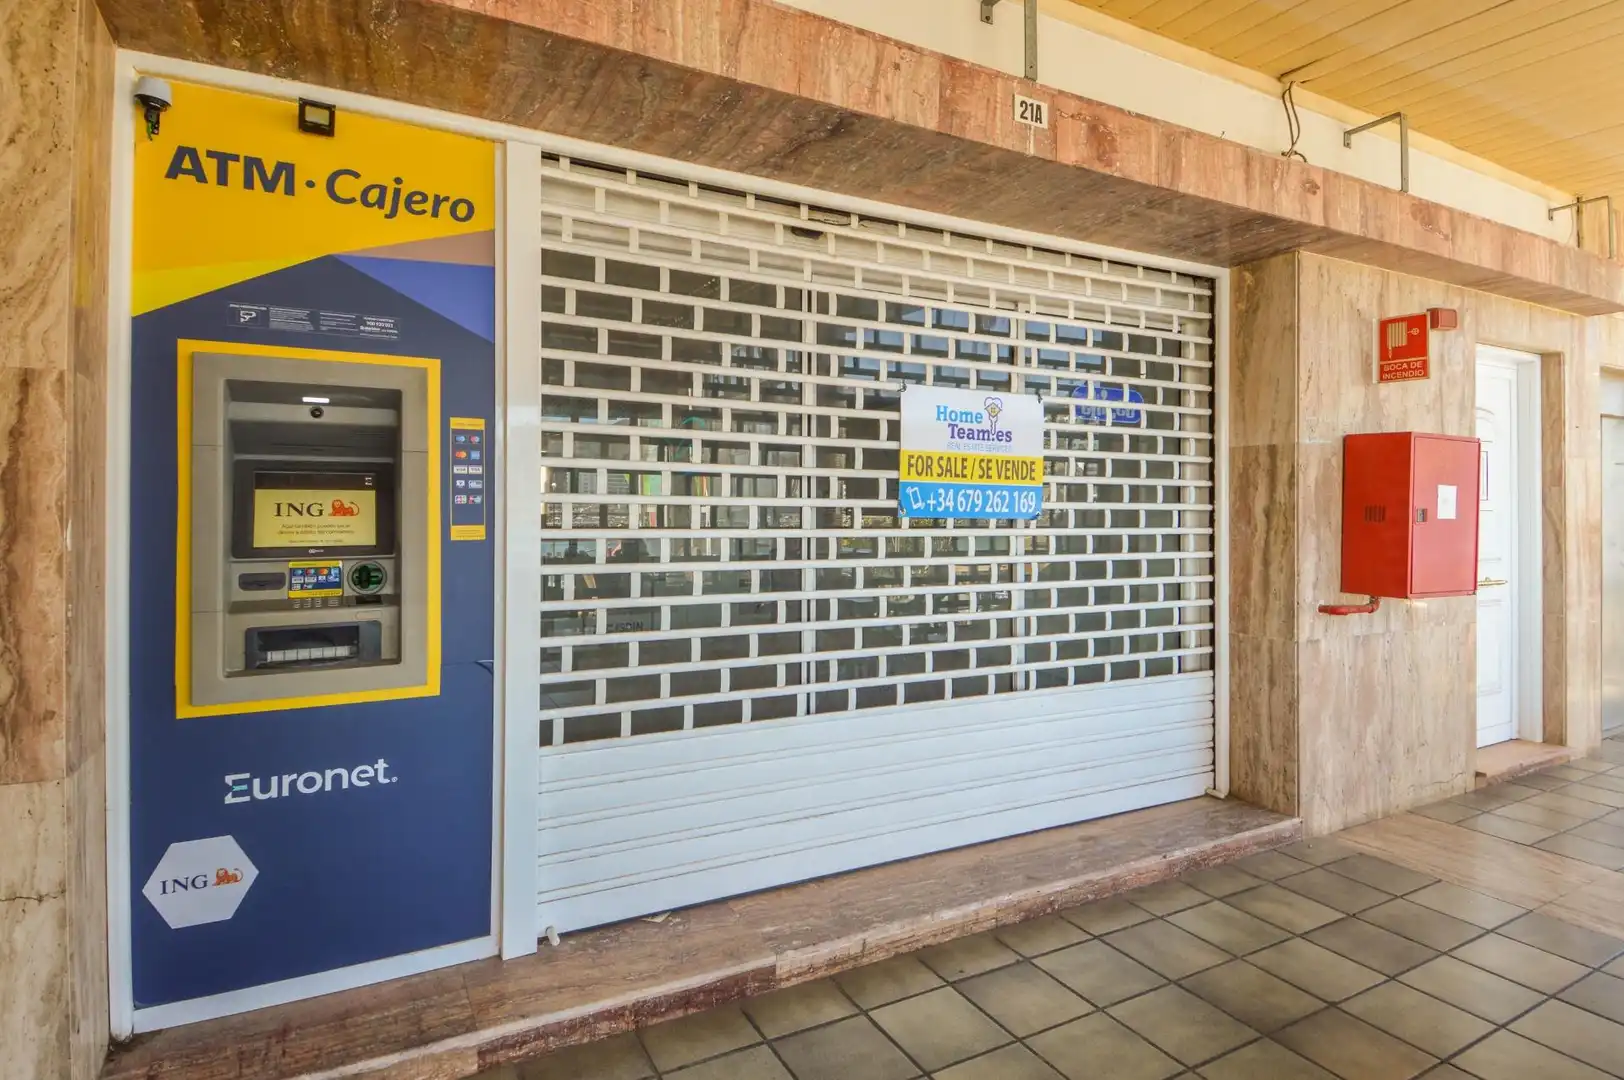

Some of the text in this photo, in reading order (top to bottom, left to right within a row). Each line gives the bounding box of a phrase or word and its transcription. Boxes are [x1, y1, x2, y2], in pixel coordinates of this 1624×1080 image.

[1020, 100, 1042, 124] 21A
[164, 145, 296, 197] ATM
[325, 168, 475, 223] Cajero
[1383, 361, 1424, 371] BOCA DE
[1383, 370, 1425, 379] INCENDIO
[935, 405, 983, 424] Home
[907, 455, 934, 477] FOR
[937, 456, 968, 479] SALE
[978, 458, 993, 480] SE
[996, 459, 1037, 481] VENDE
[274, 502, 324, 517] ING
[927, 488, 1036, 513] +34 679 262 169
[160, 874, 208, 896] ING
